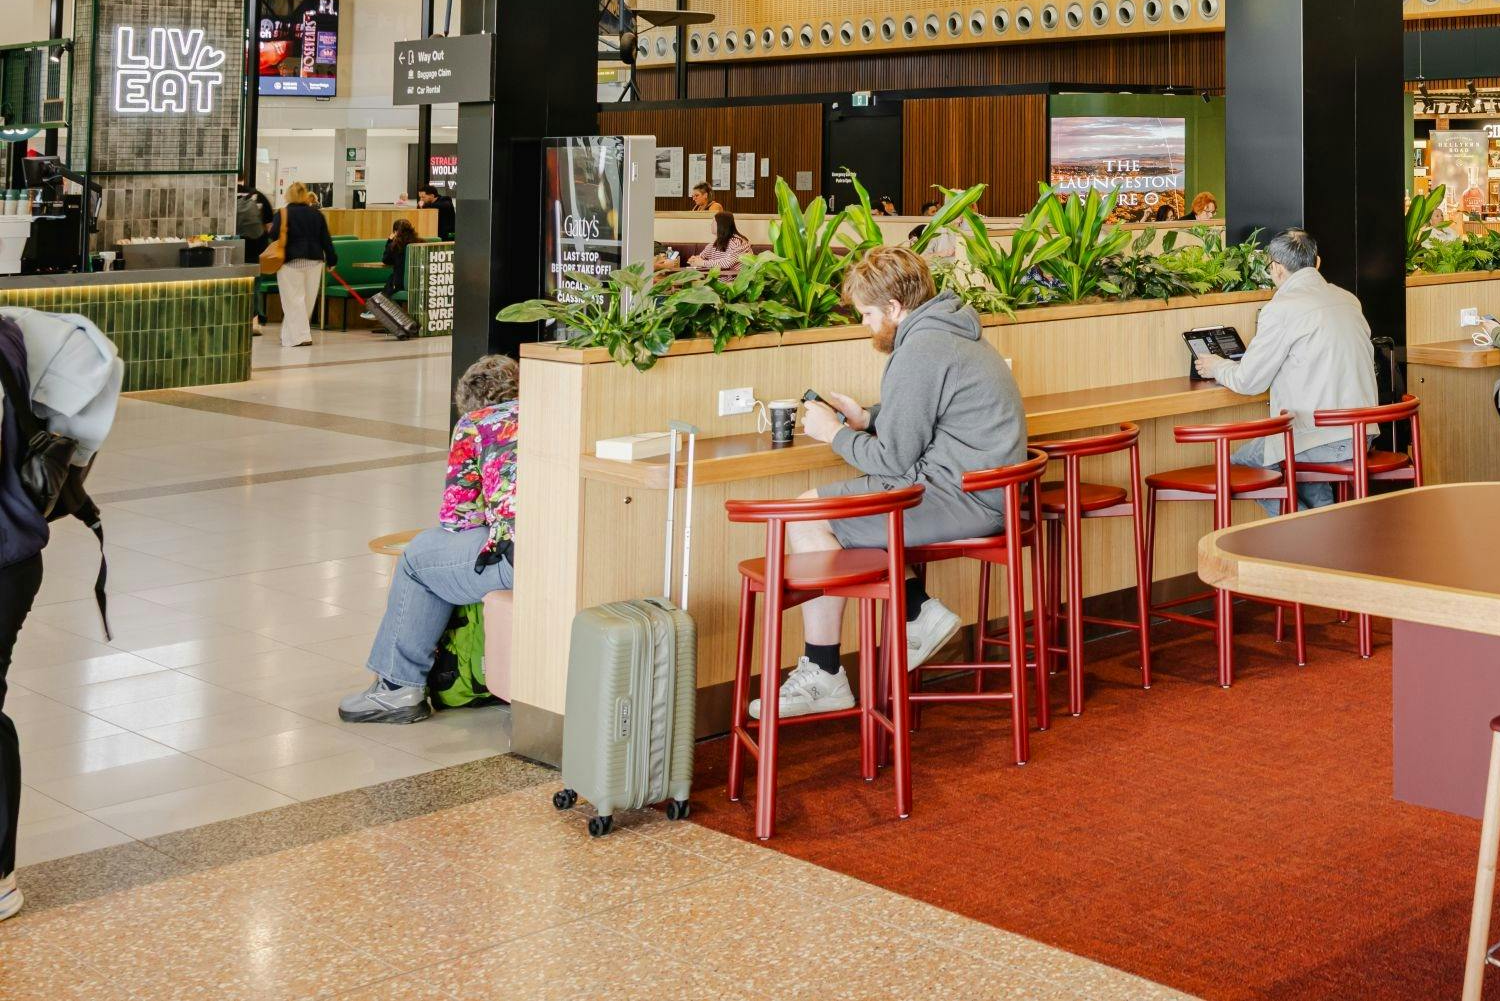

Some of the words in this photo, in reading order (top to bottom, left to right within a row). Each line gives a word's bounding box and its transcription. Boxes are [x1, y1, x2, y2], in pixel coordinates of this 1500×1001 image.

[418, 51, 431, 63] Way
[432, 50, 444, 61] Out
[417, 70, 437, 80] Baggage
[438, 68, 451, 78] Claim
[115, 69, 223, 113] EAT
[417, 87, 425, 95] Car
[426, 85, 441, 94] Rental
[1103, 160, 1140, 172] THE
[1060, 176, 1177, 189] LAUNCESTON
[564, 214, 600, 241] Gatty's
[429, 251, 454, 262] HOT
[563, 252, 580, 261] LAST
[581, 252, 600, 261] STOP
[551, 263, 575, 274] BEFORE
[577, 265, 594, 274] TAKE
[596, 265, 612, 275] OFF!
